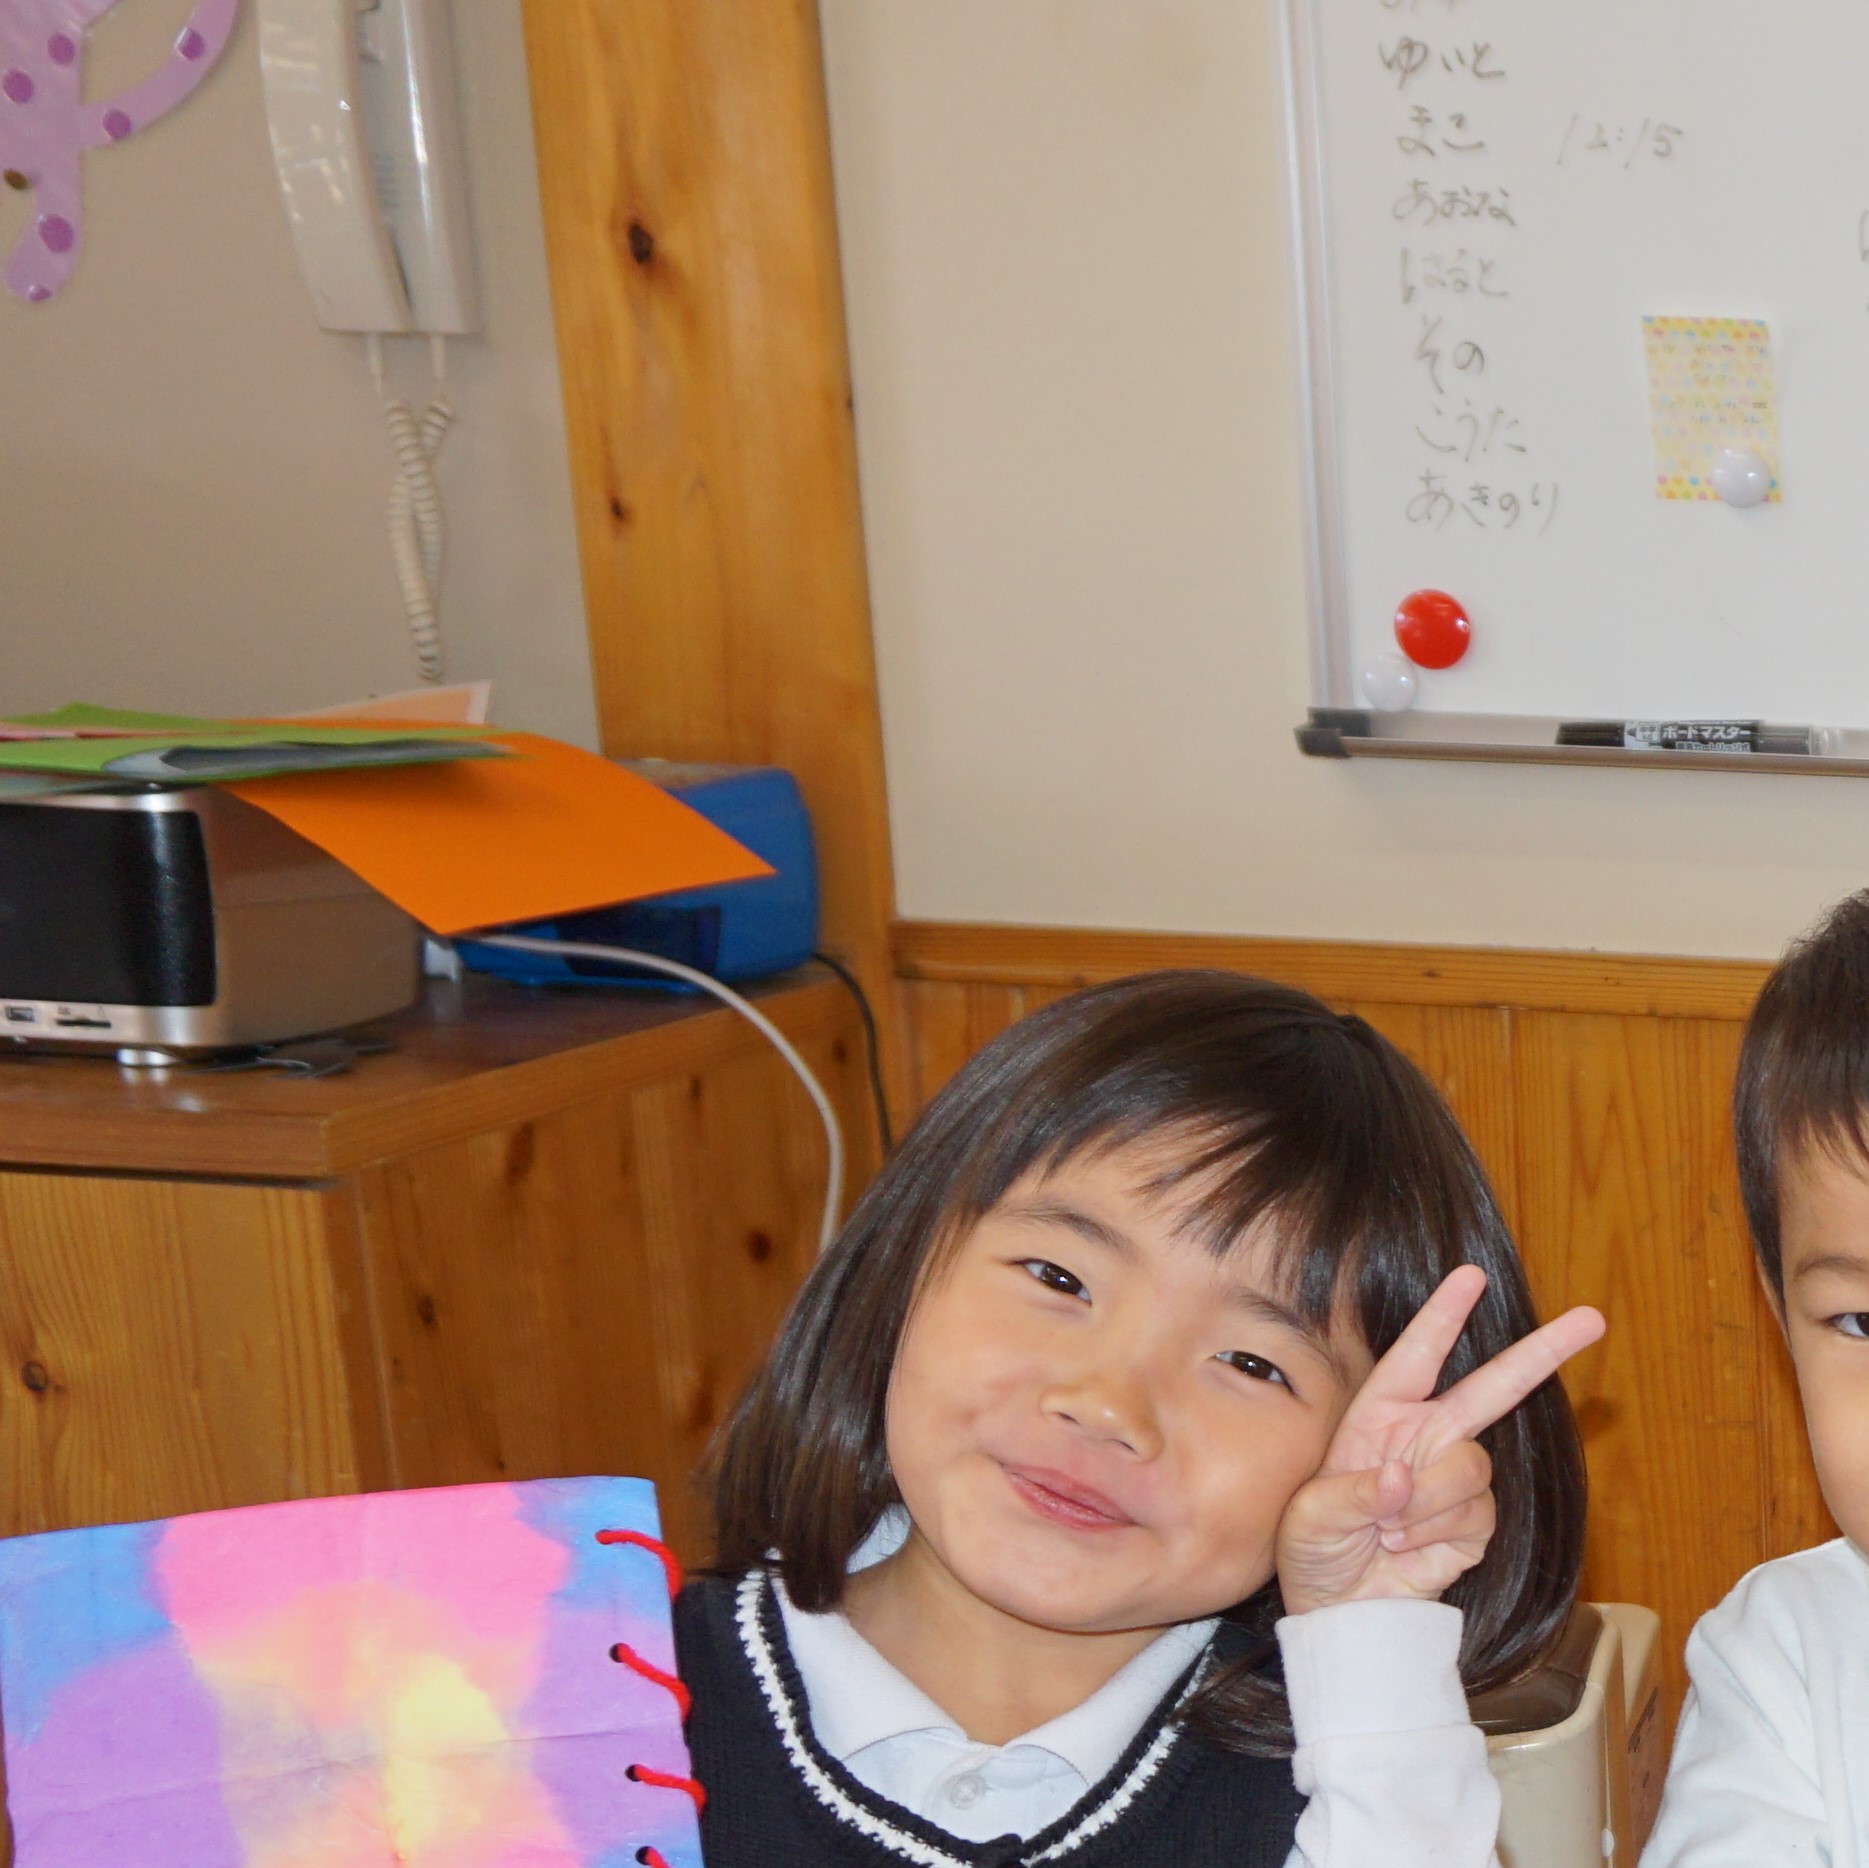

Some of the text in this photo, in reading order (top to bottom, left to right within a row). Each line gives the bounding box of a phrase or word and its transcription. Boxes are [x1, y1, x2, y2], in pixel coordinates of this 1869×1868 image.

[1415, 313, 1486, 394] その
[1405, 467, 1560, 540] あきのり
[1662, 726, 1751, 739] ボードマスター
